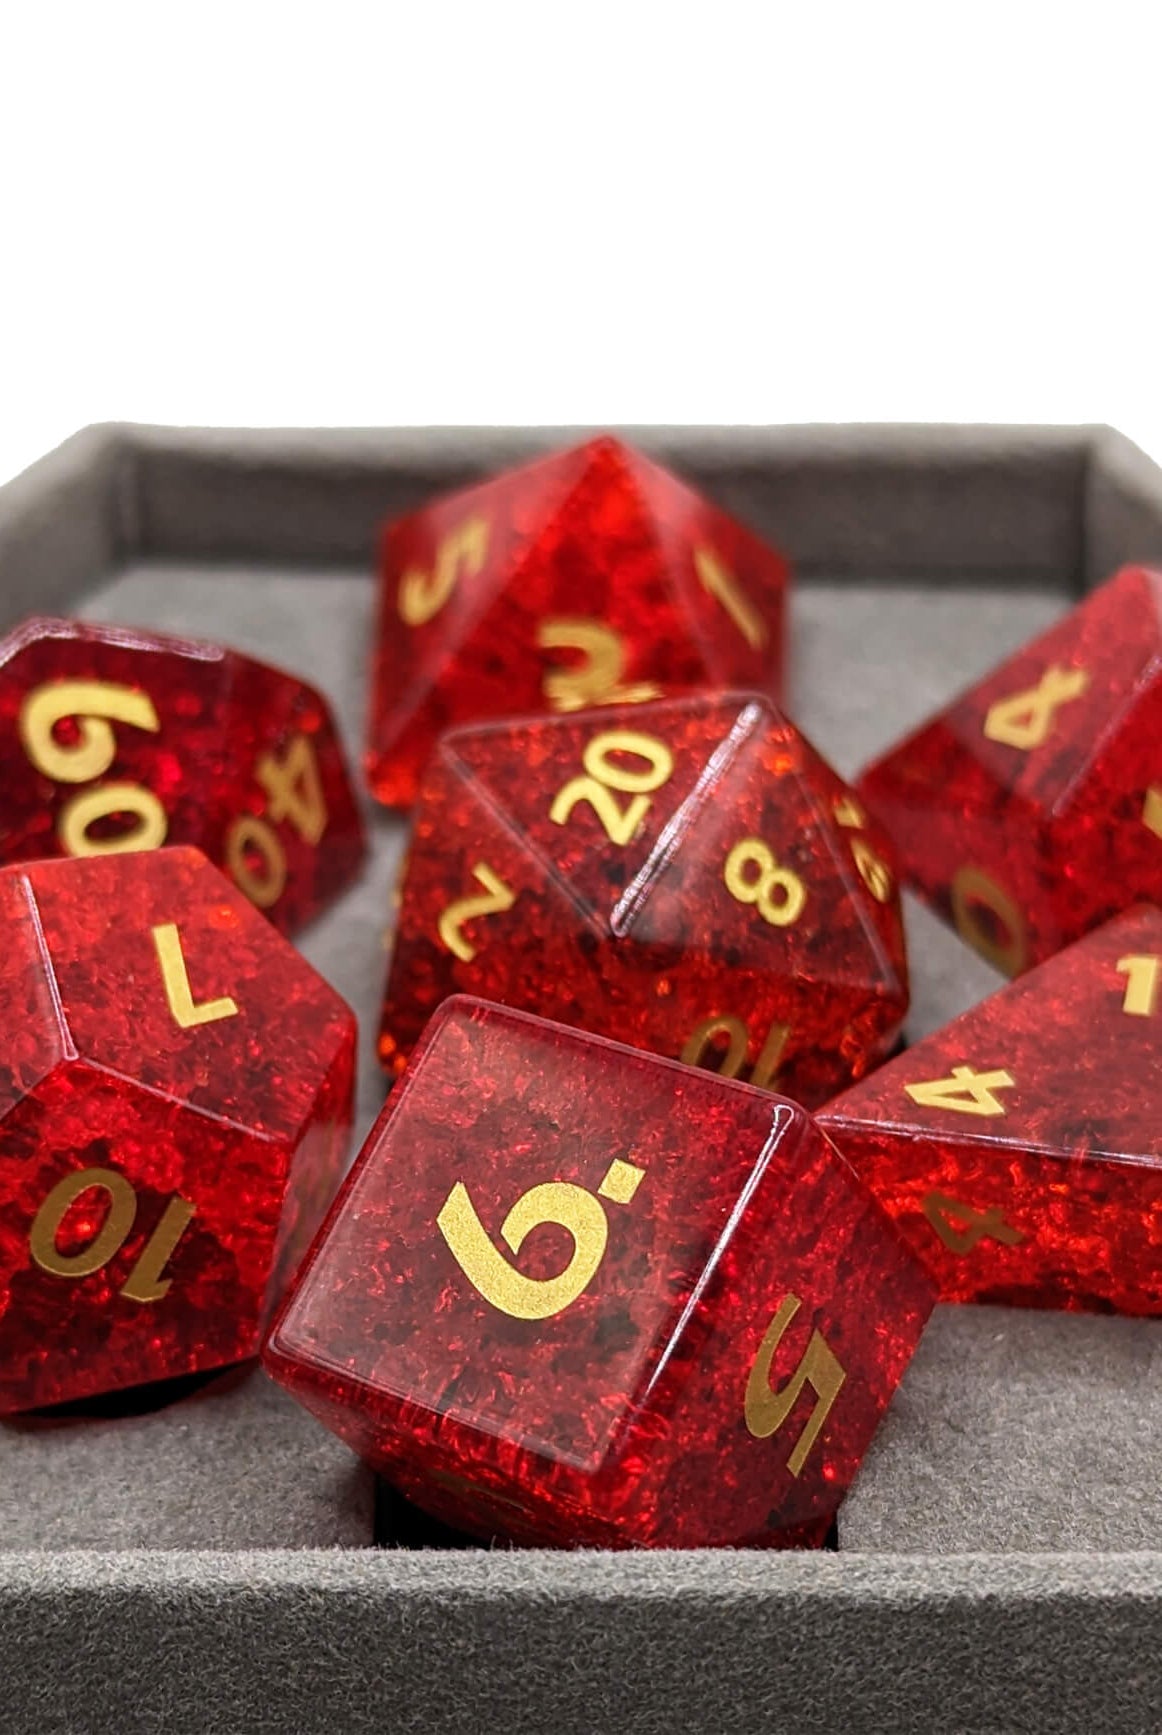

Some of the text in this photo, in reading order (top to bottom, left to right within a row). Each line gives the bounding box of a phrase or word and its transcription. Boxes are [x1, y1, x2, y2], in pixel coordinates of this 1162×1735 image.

[984, 662, 1090, 750] 4
[549, 730, 673, 846] 20
[724, 838, 805, 927] 8
[152, 922, 239, 1029] 7
[1115, 954, 1159, 1017] 1
[904, 1065, 1016, 1117] 4
[29, 1166, 197, 1303] 10
[923, 1190, 1024, 1257] 4
[744, 1292, 847, 1478] 5
